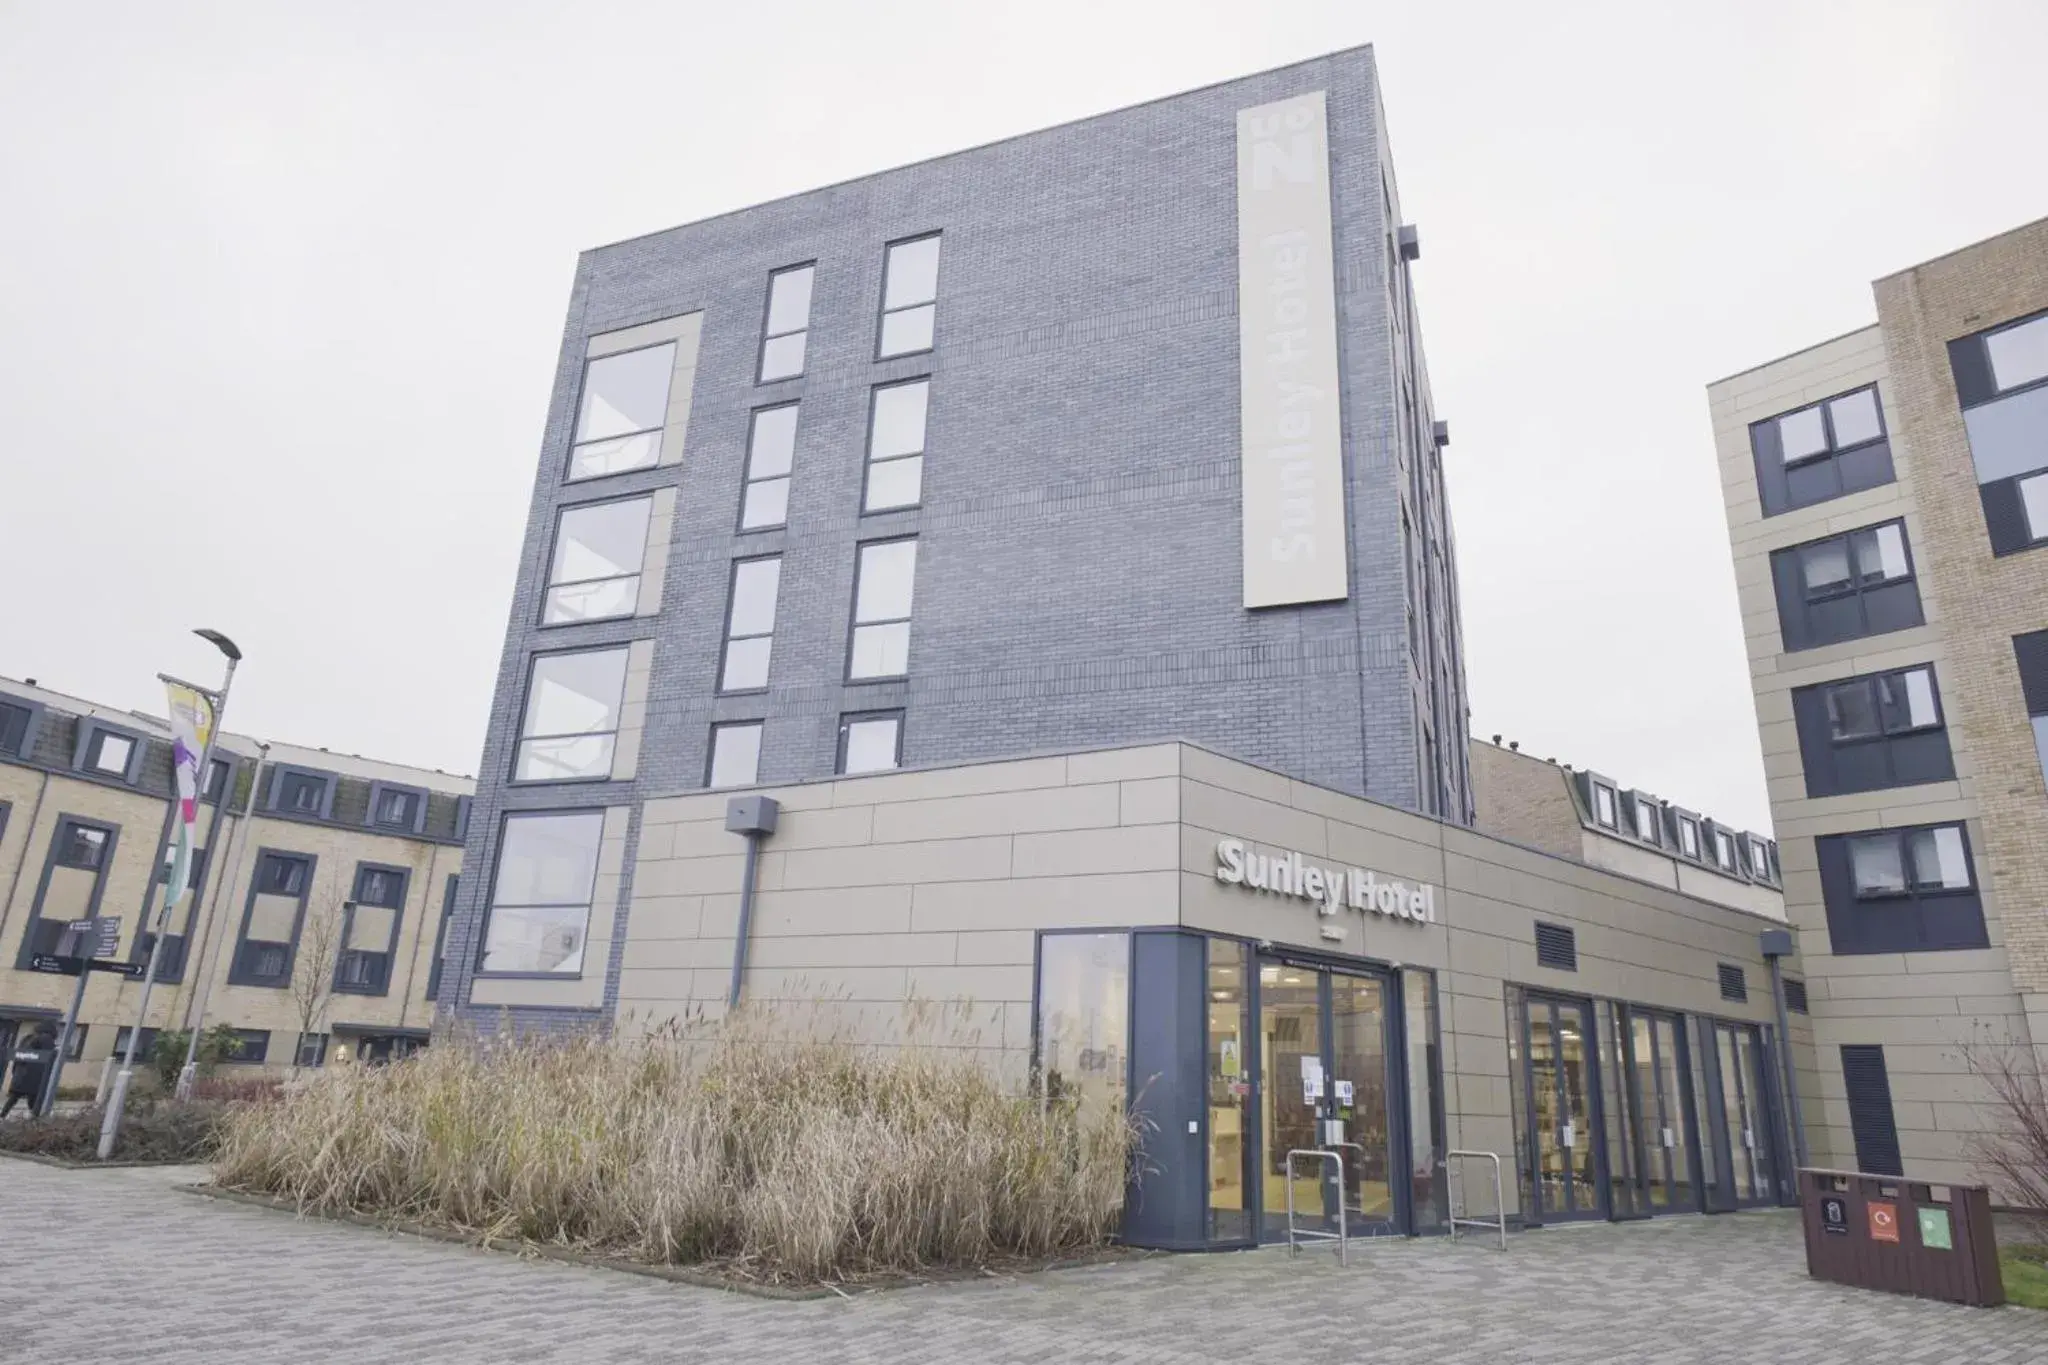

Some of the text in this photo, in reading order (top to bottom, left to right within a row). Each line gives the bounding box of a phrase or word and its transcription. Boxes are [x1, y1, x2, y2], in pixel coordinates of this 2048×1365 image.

[1259, 229, 1326, 563] Sunley Hotel
[1217, 838, 1436, 924] Sunley Hotel
